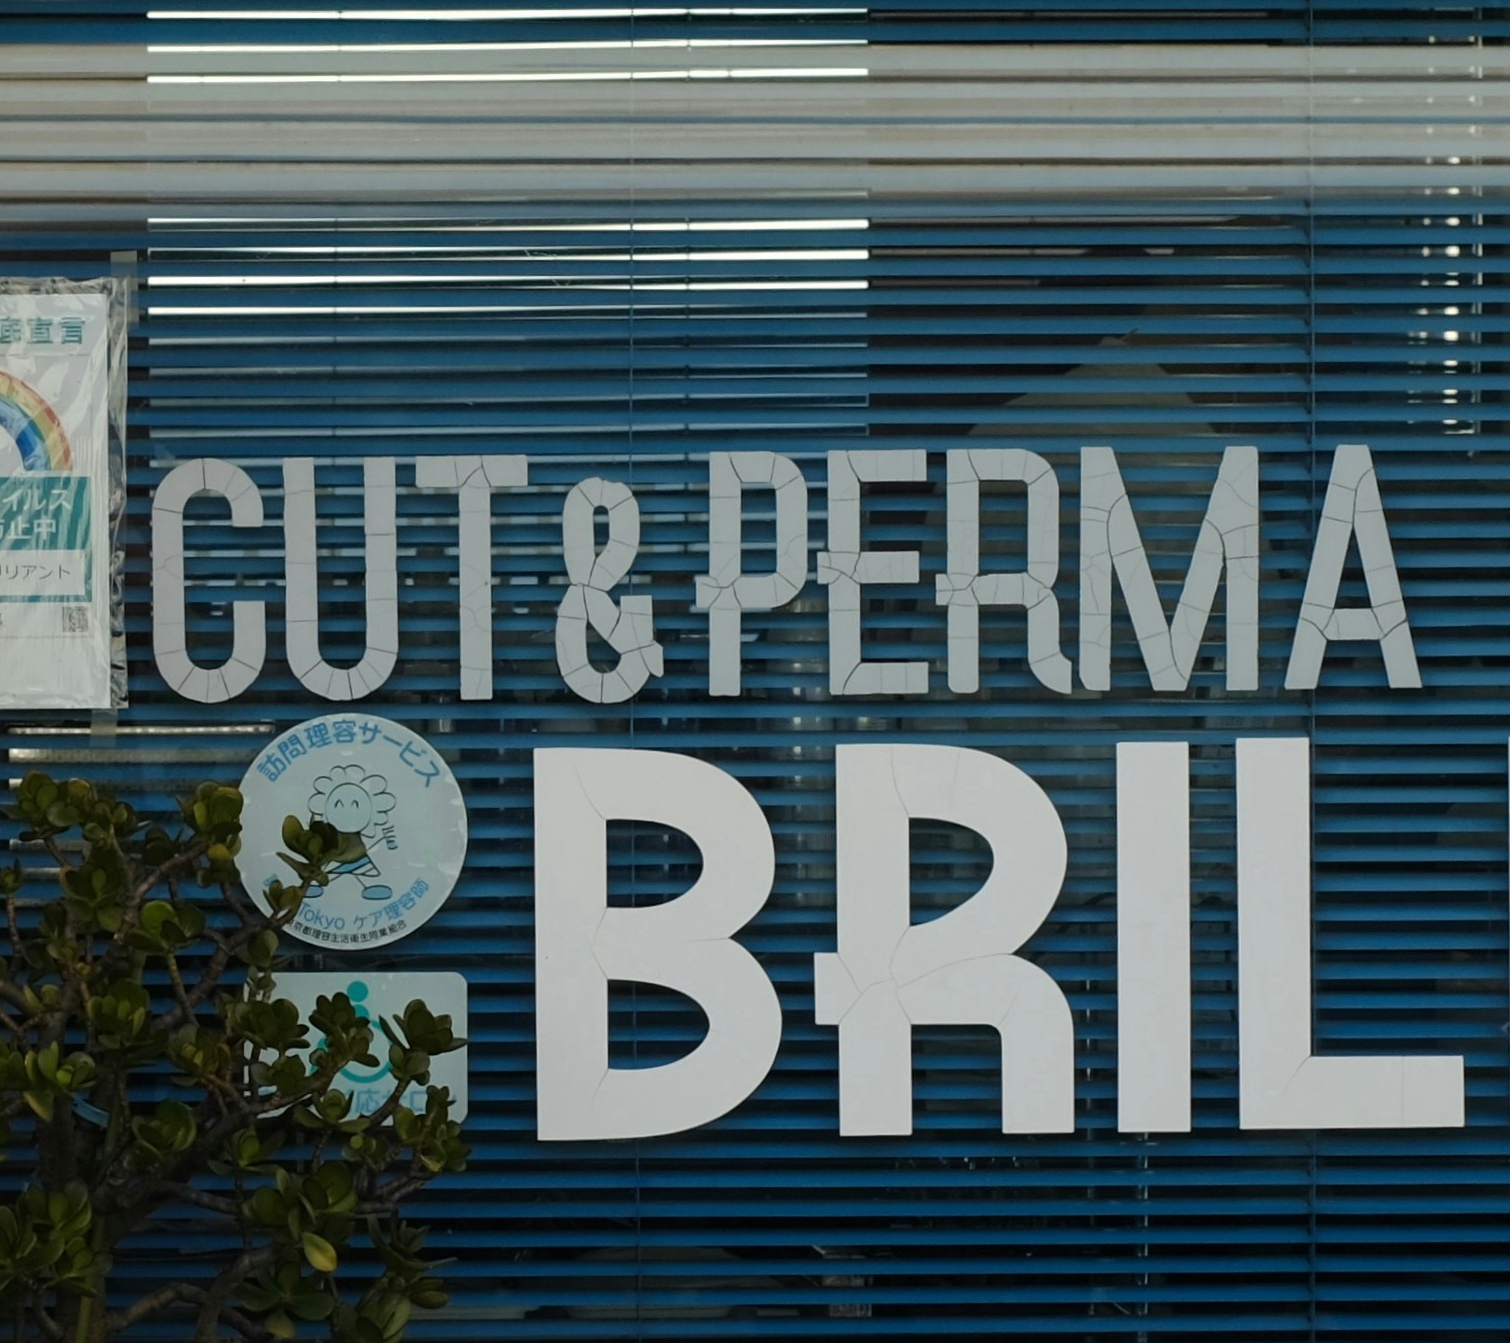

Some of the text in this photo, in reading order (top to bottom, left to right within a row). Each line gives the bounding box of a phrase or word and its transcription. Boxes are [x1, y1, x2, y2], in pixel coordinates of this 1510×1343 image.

[152, 444, 1422, 703] CUT & PERMA
[255, 719, 442, 789] 訪問理容サービス
[297, 877, 430, 931] Tokyo ケア理容師
